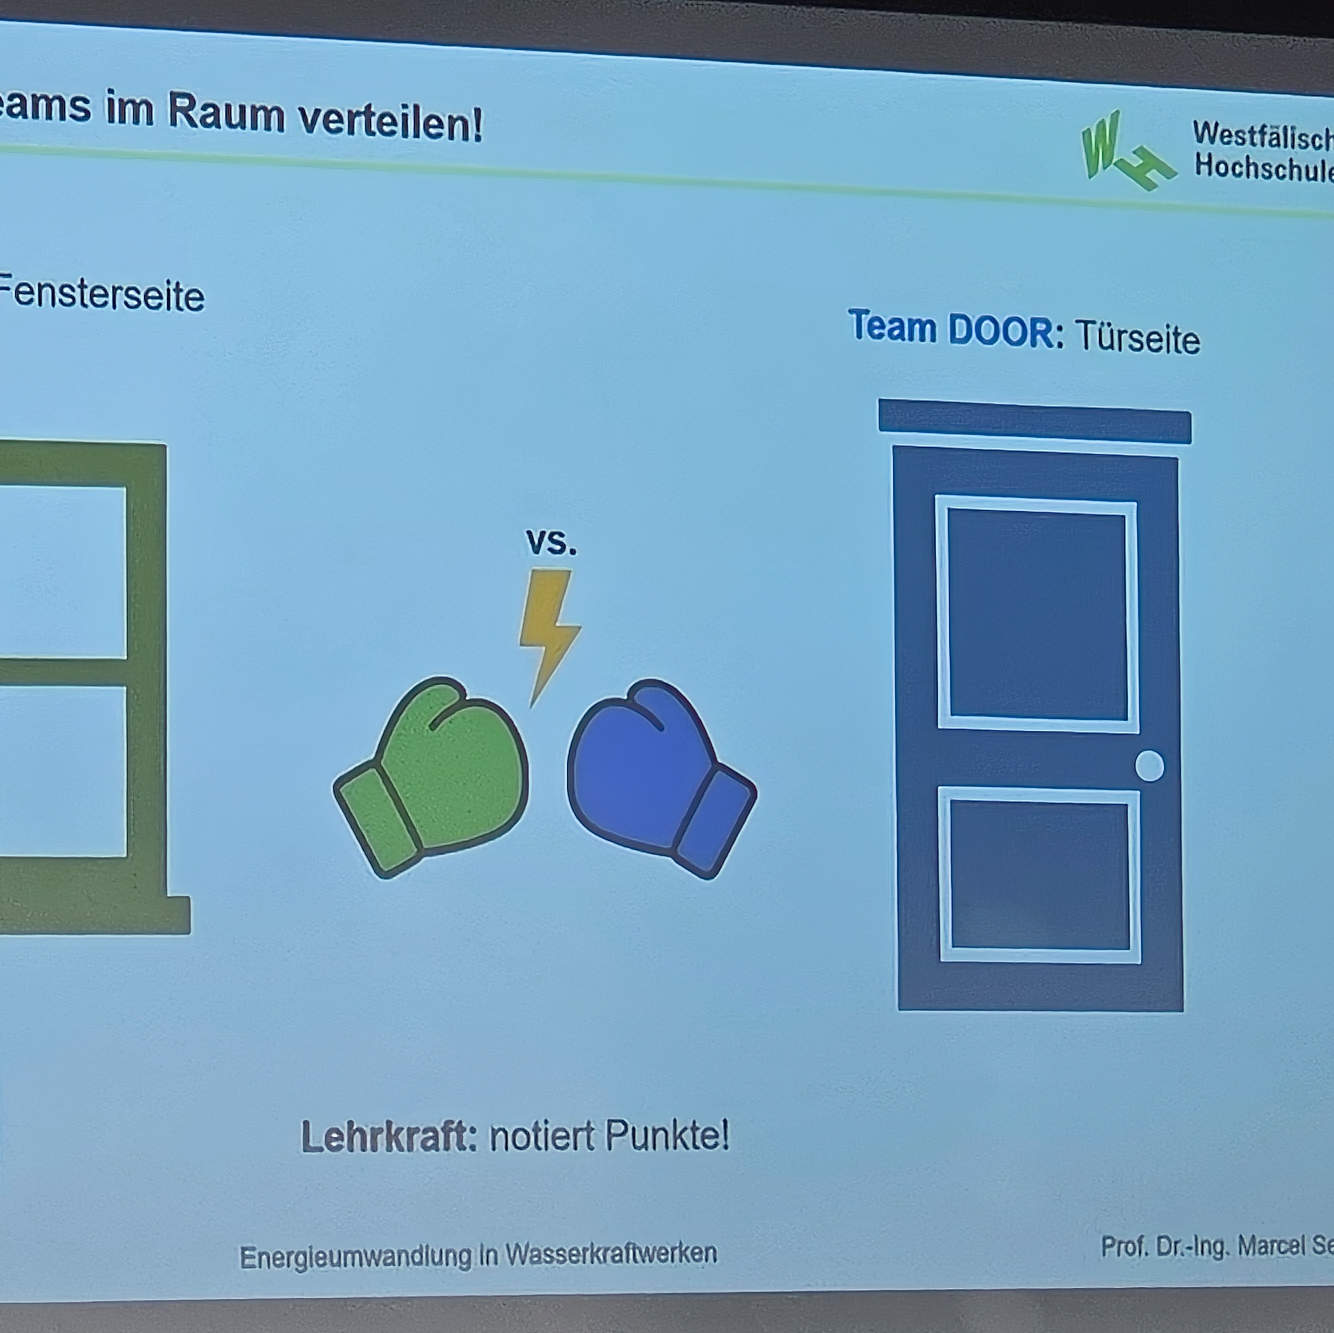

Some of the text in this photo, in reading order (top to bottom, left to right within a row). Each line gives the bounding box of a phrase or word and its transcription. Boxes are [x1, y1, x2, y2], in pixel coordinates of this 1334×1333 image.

[106, 87, 154, 127] im
[169, 90, 285, 134] Raum
[298, 102, 482, 143] verteilen!
[847, 307, 1201, 355] Team DOOR: Türseite
[525, 529, 577, 556] vs.
[302, 1117, 730, 1153] Lehrkraft: notiert Punkte!
[240, 1239, 718, 1274] Energieumwandlung in Wasserkraftwerken
[1101, 1234, 1149, 1259] Prof.
[1156, 1233, 1231, 1262] Dr.-Ing.
[1238, 1233, 1306, 1257] Marcel
